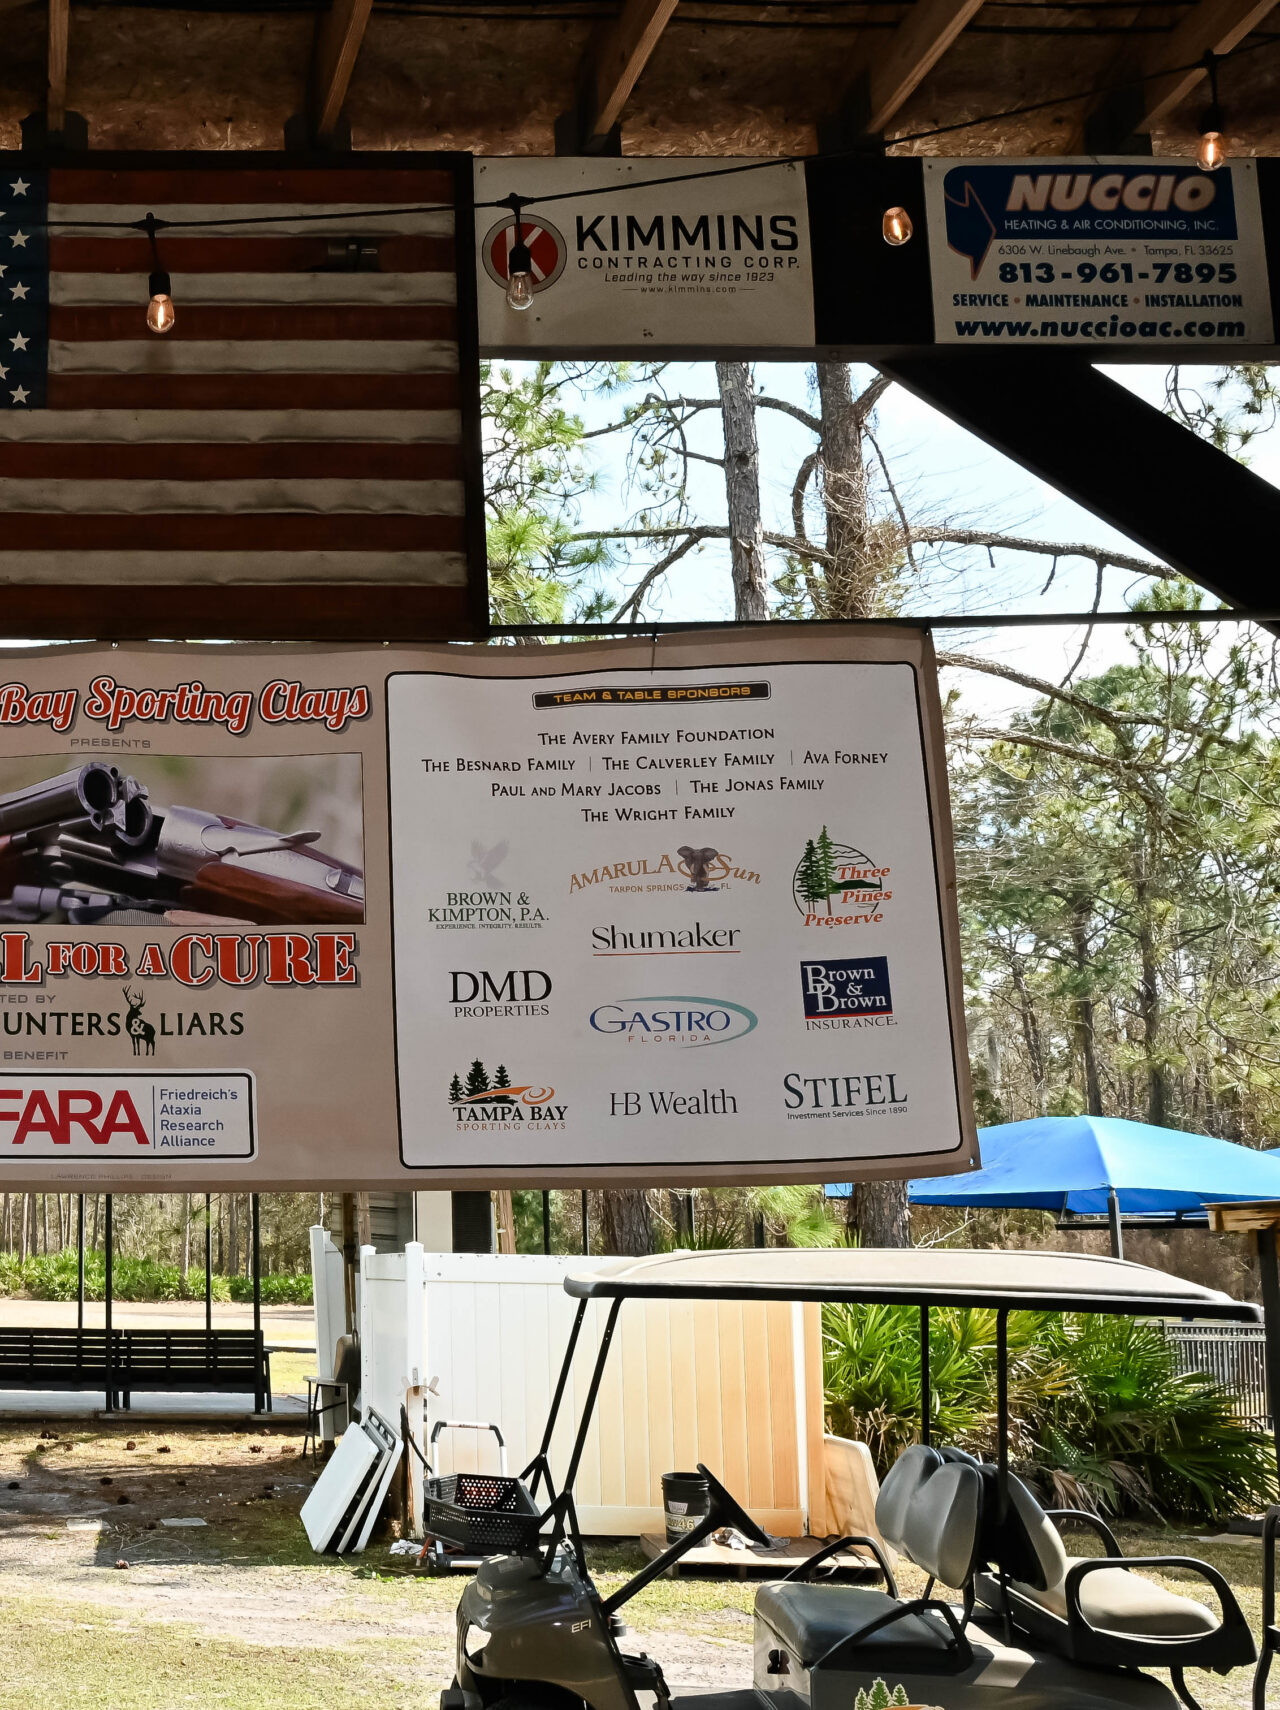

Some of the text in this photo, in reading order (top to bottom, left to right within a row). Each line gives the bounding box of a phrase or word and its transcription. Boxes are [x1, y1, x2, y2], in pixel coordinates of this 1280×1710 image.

[1005, 175, 1216, 212] NUCCIO
[1005, 220, 1219, 232] HEATING & AIR CONDITIONING, INC.
[576, 216, 798, 251] KIMMINS
[578, 256, 799, 269] CONTRACTING CORP.
[605, 273, 774, 283] Leading the way since 1923
[641, 285, 736, 293] www.kimmins.com
[953, 294, 1242, 307] SERVICE MAINTENANCE INSTALLATION
[955, 315, 1245, 337] www.nuccioac.com
[554, 687, 750, 702] TEAM & TABLE SPONSORS
[85, 677, 253, 733] Sporting
[260, 680, 368, 732] Clays
[71, 739, 150, 748] PRESENTS
[837, 867, 890, 880] Three
[609, 885, 642, 893] TARPON
[647, 884, 684, 892] SPRINGS
[447, 892, 530, 905] BROWN &
[841, 890, 892, 904] Pines
[428, 908, 549, 923] KIMPTON, P.A.
[803, 913, 883, 927] Preserve
[592, 922, 741, 950] Shumaker
[46, 942, 128, 976] FOR
[136, 943, 167, 976] A
[170, 933, 356, 986] CURE
[803, 965, 875, 994] Brown
[448, 970, 552, 1003] DMD
[847, 983, 862, 995] &
[36, 995, 56, 1003] BY
[816, 983, 887, 1013] Brown
[455, 1005, 549, 1017] PROPERTIES
[130, 1019, 145, 1035] &
[160, 1012, 244, 1035] LIARS
[590, 1005, 731, 1033] GASTRO
[629, 1035, 711, 1043] FLORIDA
[4, 1051, 68, 1060] BENEFIT
[160, 1089, 237, 1100] Friedreich's
[784, 1073, 908, 1109] STIFEL
[610, 1089, 738, 1116] HB Wealth
[160, 1104, 201, 1115] Ataxia
[453, 1105, 568, 1121] TAMPA BAY
[787, 1111, 830, 1120] Investment
[832, 1110, 863, 1118] Services
[866, 1108, 886, 1116] Since
[160, 1120, 223, 1131] Research
[457, 1122, 565, 1131] SPORTING CLAYS
[160, 1135, 215, 1146] Alliance
[572, 1619, 591, 1633] EFI
